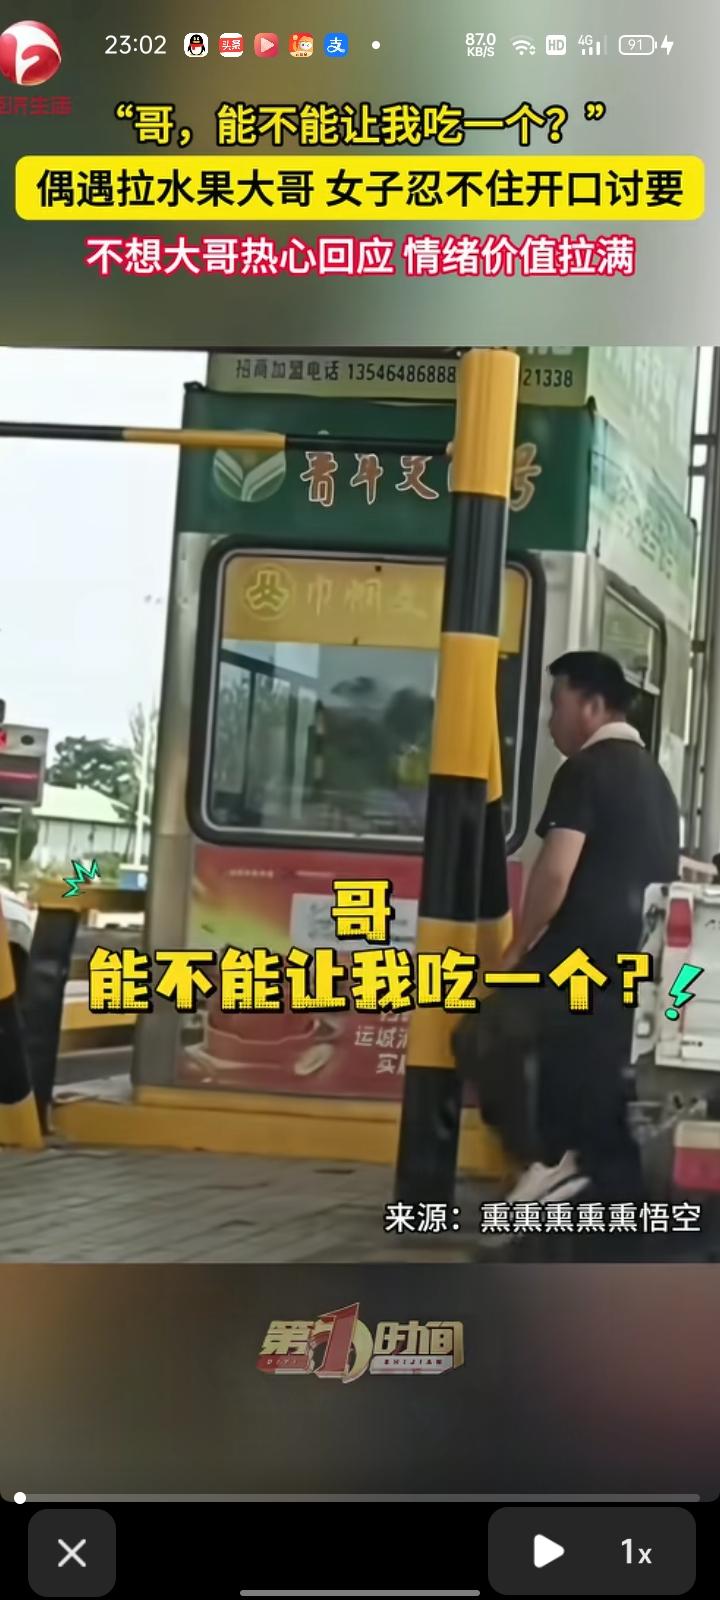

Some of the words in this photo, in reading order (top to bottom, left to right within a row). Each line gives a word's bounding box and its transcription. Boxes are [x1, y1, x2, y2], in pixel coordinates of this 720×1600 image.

[236, 359, 340, 381] 招商加盟电话
[347, 363, 457, 384] 13546486888
[523, 368, 574, 388] 21338
